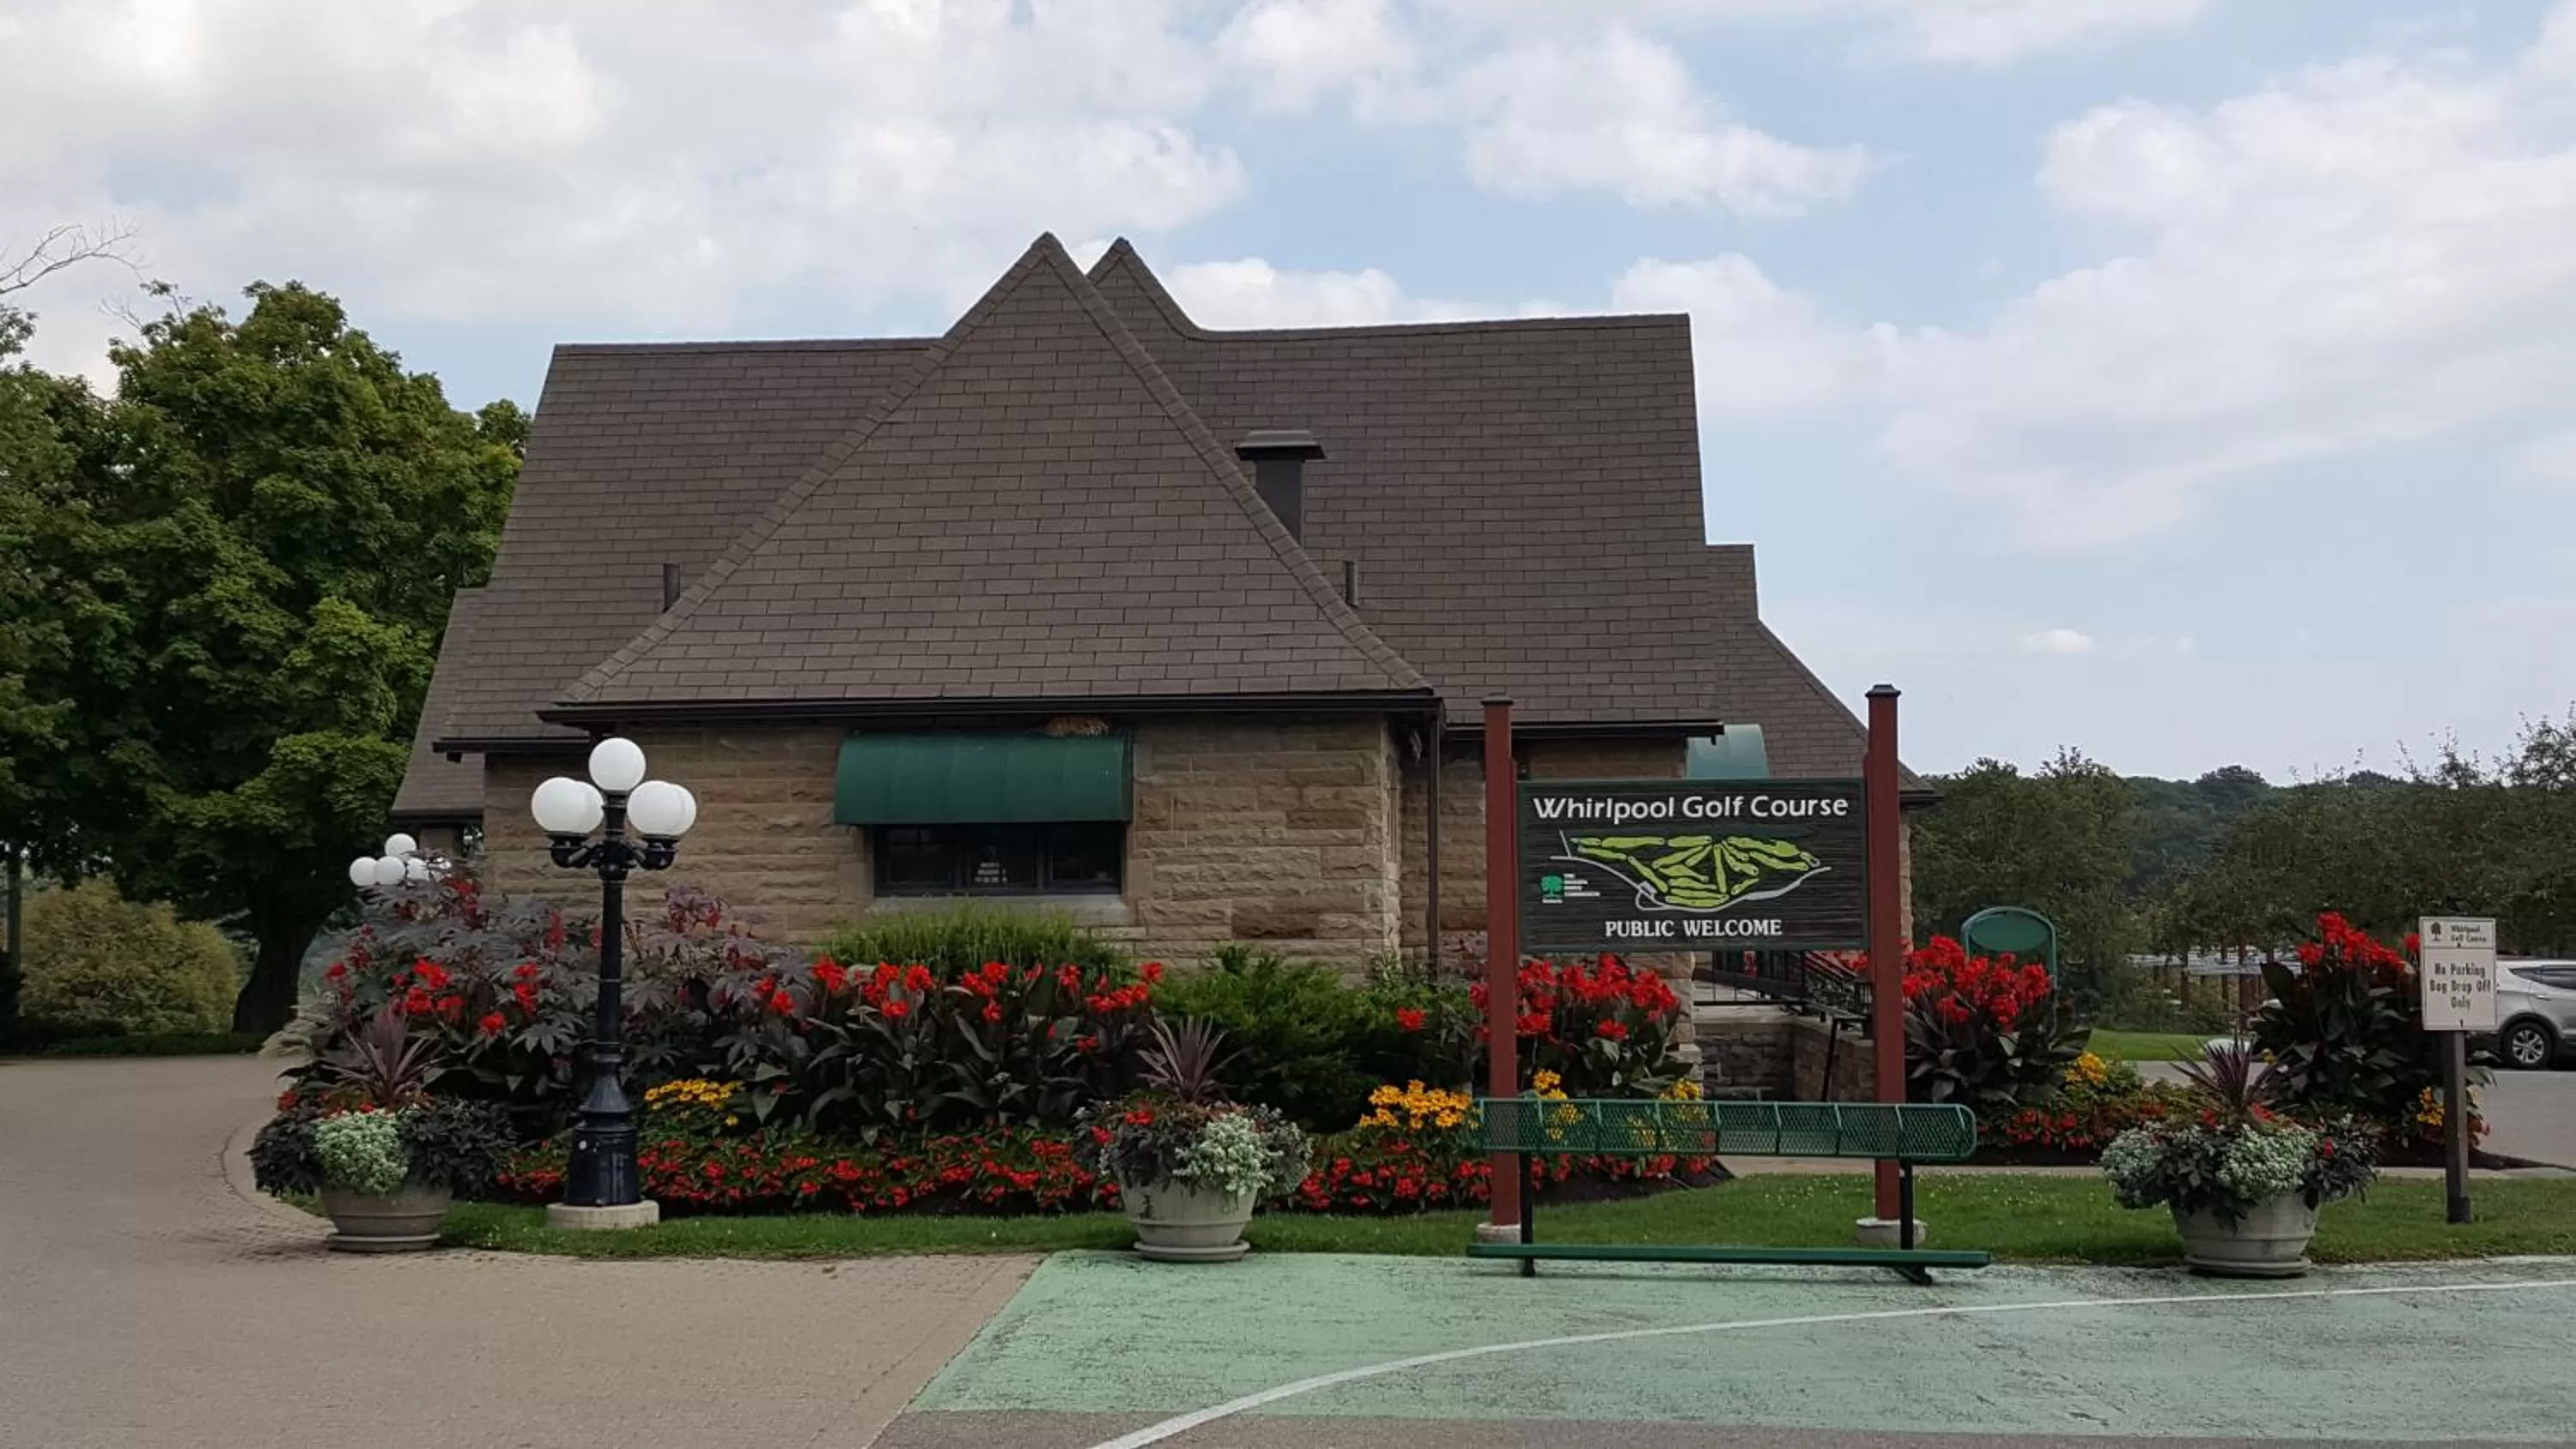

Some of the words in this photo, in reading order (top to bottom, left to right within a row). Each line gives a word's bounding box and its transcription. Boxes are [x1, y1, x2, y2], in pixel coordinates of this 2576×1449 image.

[1534, 797, 1674, 824] Whirlpool
[1681, 796, 1743, 817] Golf
[1750, 795, 1849, 816] Course
[1605, 920, 1674, 937] PUBLIC
[1683, 919, 1783, 937] WELCOME
[2434, 963, 2446, 975] No
[2450, 962, 2486, 979] Parking
[2429, 979, 2447, 994] Bag
[2451, 979, 2472, 994] Drop
[2476, 979, 2491, 991] Off
[2451, 996, 2470, 1009] Only
